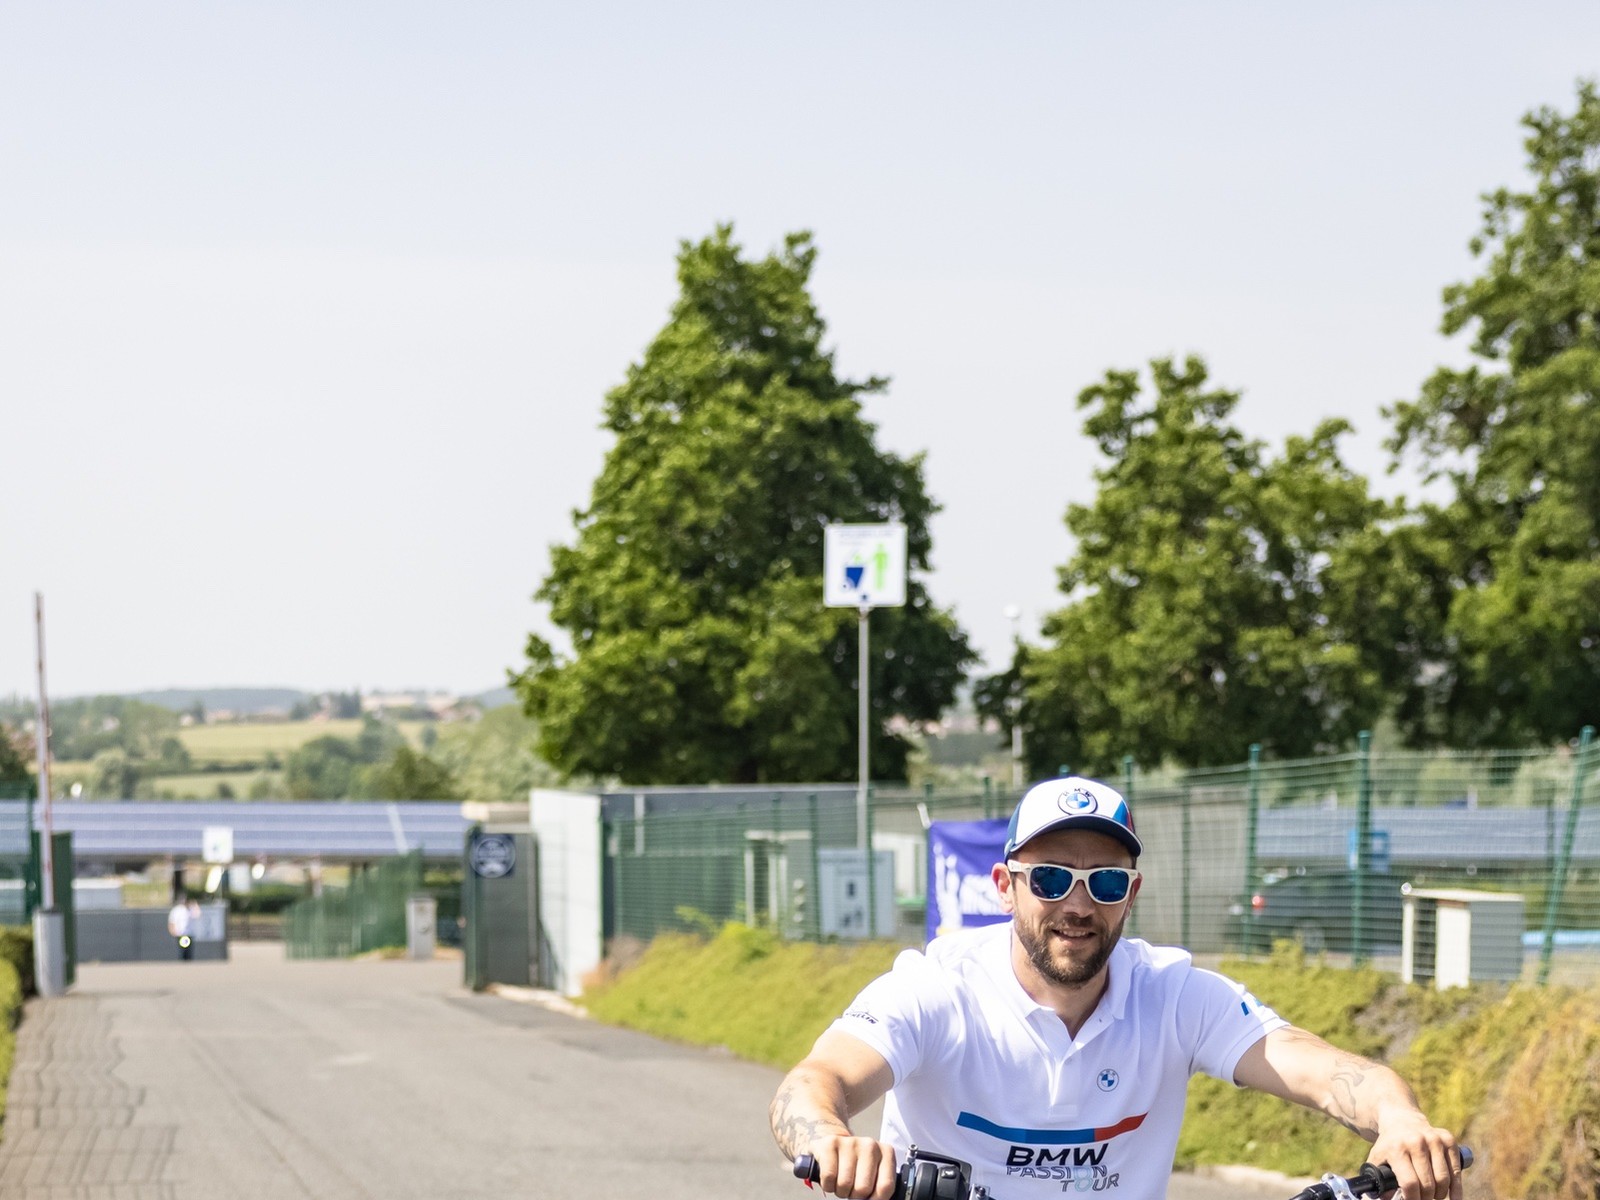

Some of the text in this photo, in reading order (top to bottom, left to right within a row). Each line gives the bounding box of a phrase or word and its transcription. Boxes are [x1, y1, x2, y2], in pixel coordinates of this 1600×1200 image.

[1006, 1143, 1109, 1167] BMW
[1006, 1165, 1108, 1180] PASSION
[1060, 1173, 1120, 1193] TOUR
